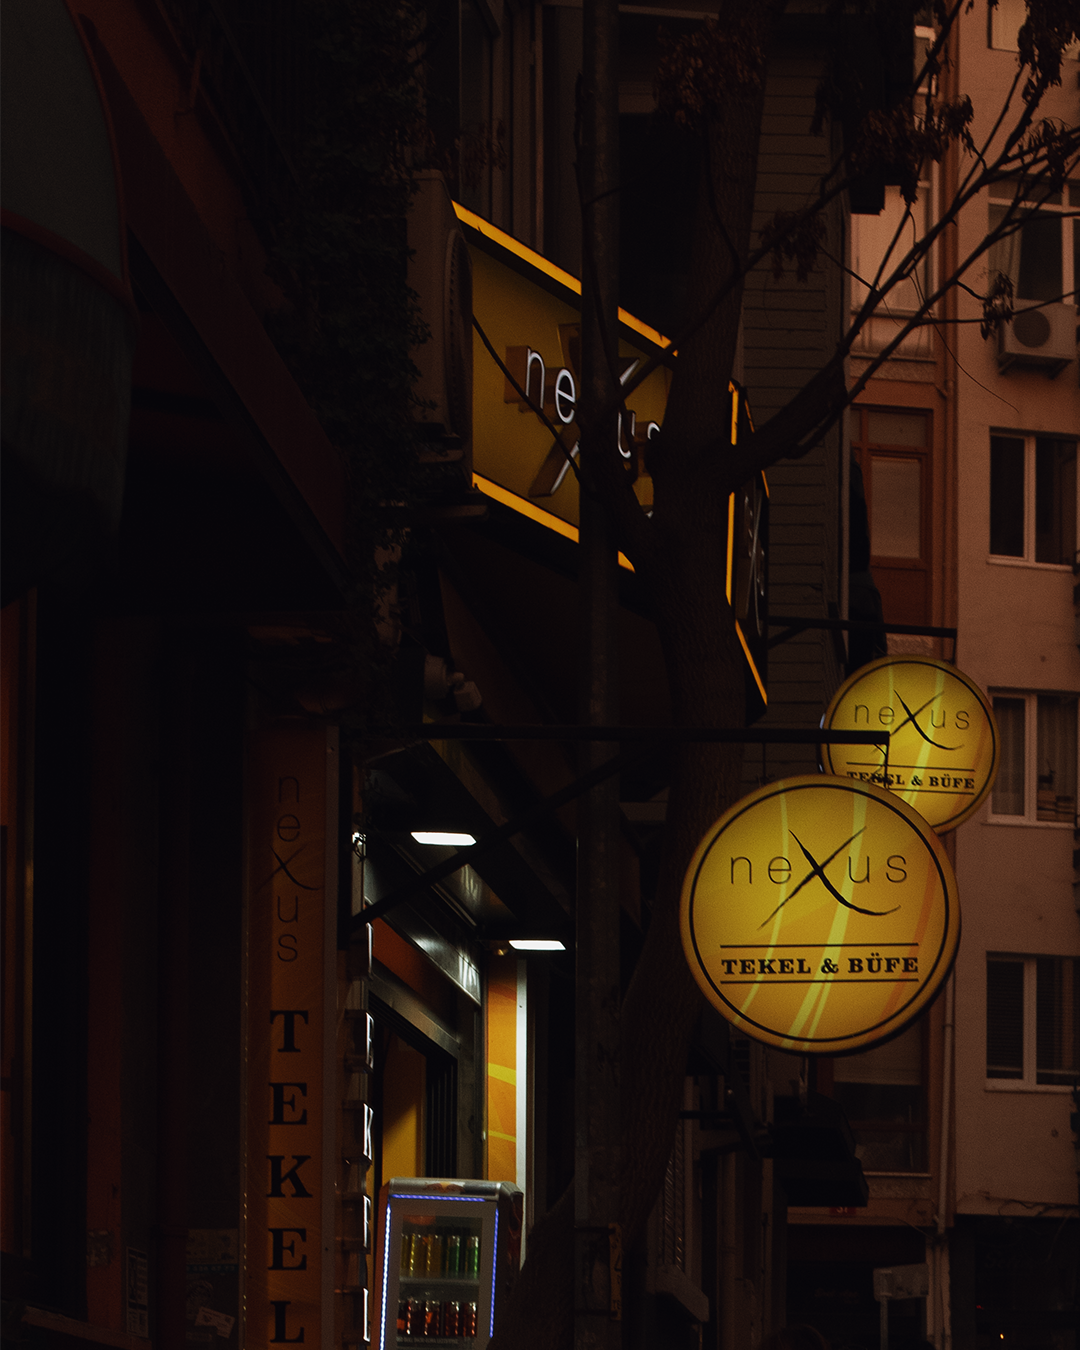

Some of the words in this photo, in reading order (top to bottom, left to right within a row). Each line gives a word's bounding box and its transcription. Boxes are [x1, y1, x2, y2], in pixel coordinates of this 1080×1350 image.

[911, 774, 922, 787] &
[929, 773, 976, 789] BÜFE
[721, 958, 811, 975] TEKEL
[821, 957, 839, 974] &
[847, 952, 919, 974] BÜFE
[266, 1010, 313, 1343] TEKEL
